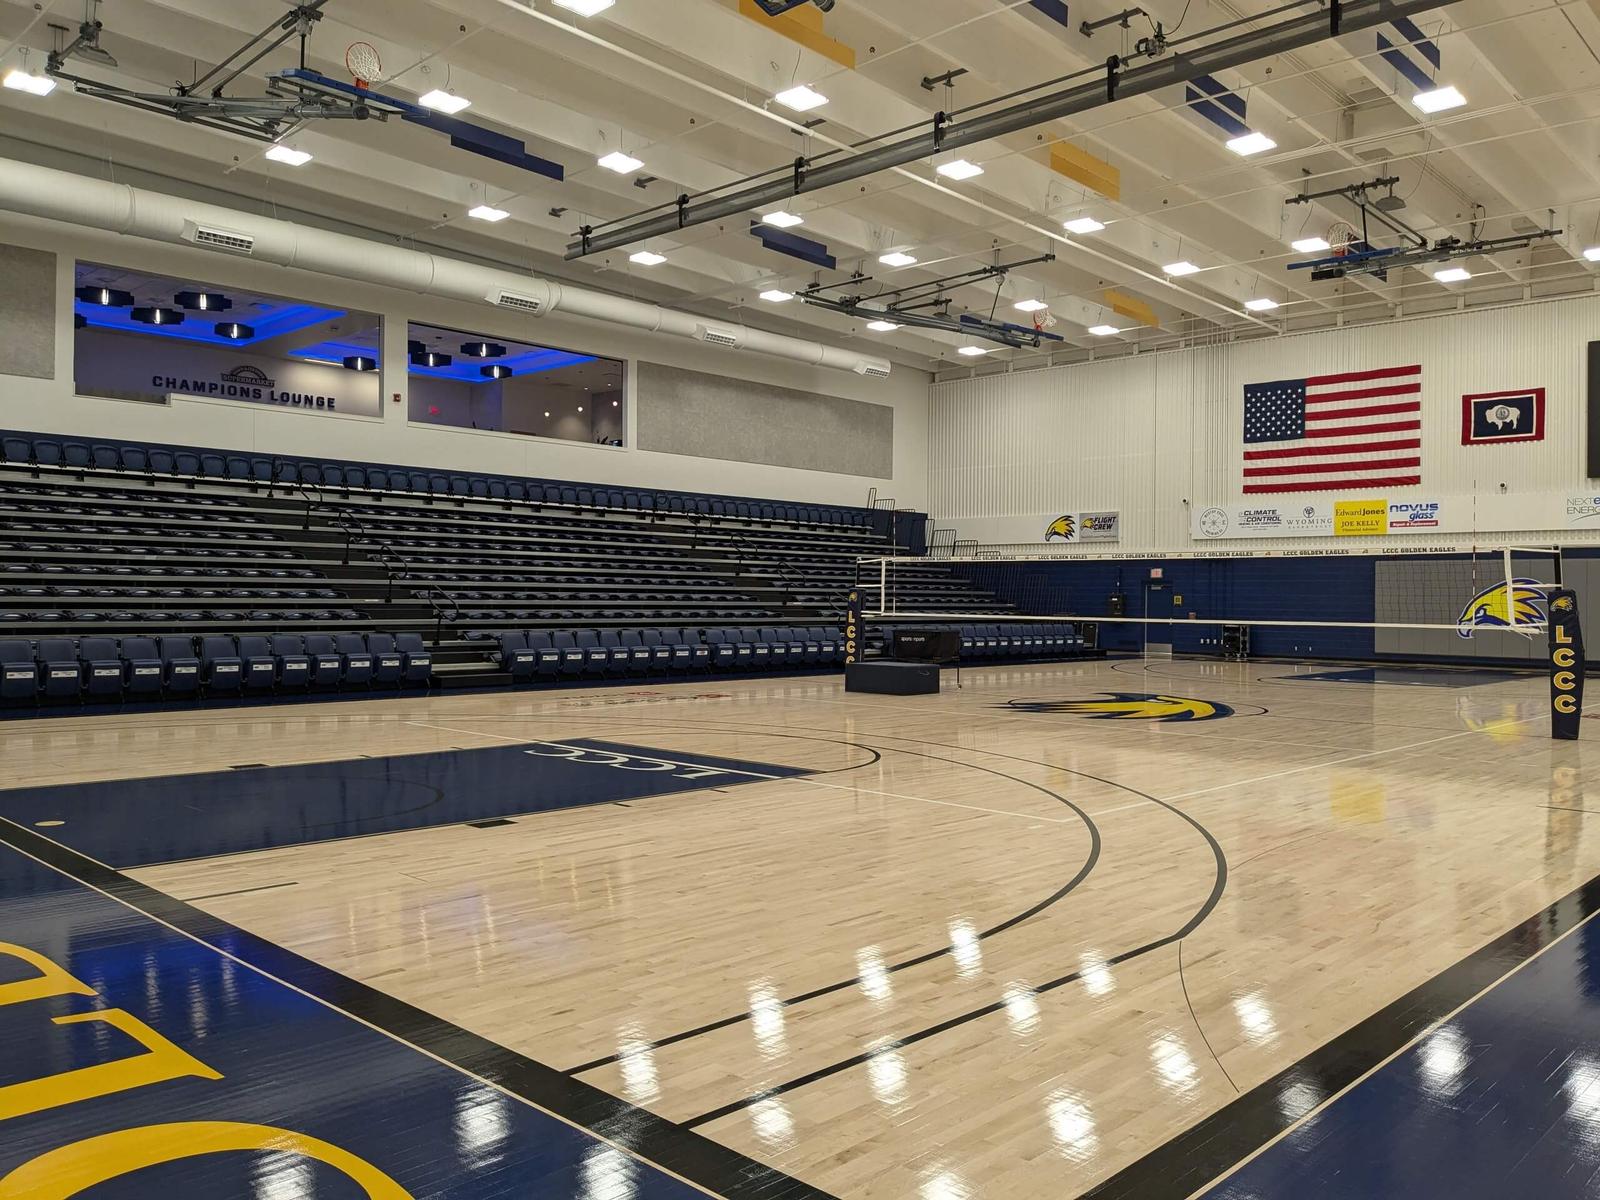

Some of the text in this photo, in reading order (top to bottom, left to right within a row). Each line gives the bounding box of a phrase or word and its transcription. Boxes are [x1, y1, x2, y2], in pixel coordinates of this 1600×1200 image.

[221, 374, 275, 388] SUPERMARKET
[152, 375, 336, 408] CHAMPIONS LOUNGE
[1094, 516, 1117, 524] FLIGHT
[1408, 511, 1435, 522] glass
[1094, 523, 1113, 531] CREW
[1341, 519, 1380, 528] JOE KELLY
[1553, 625, 1577, 714] LCCC
[523, 748, 729, 780] LCCC
